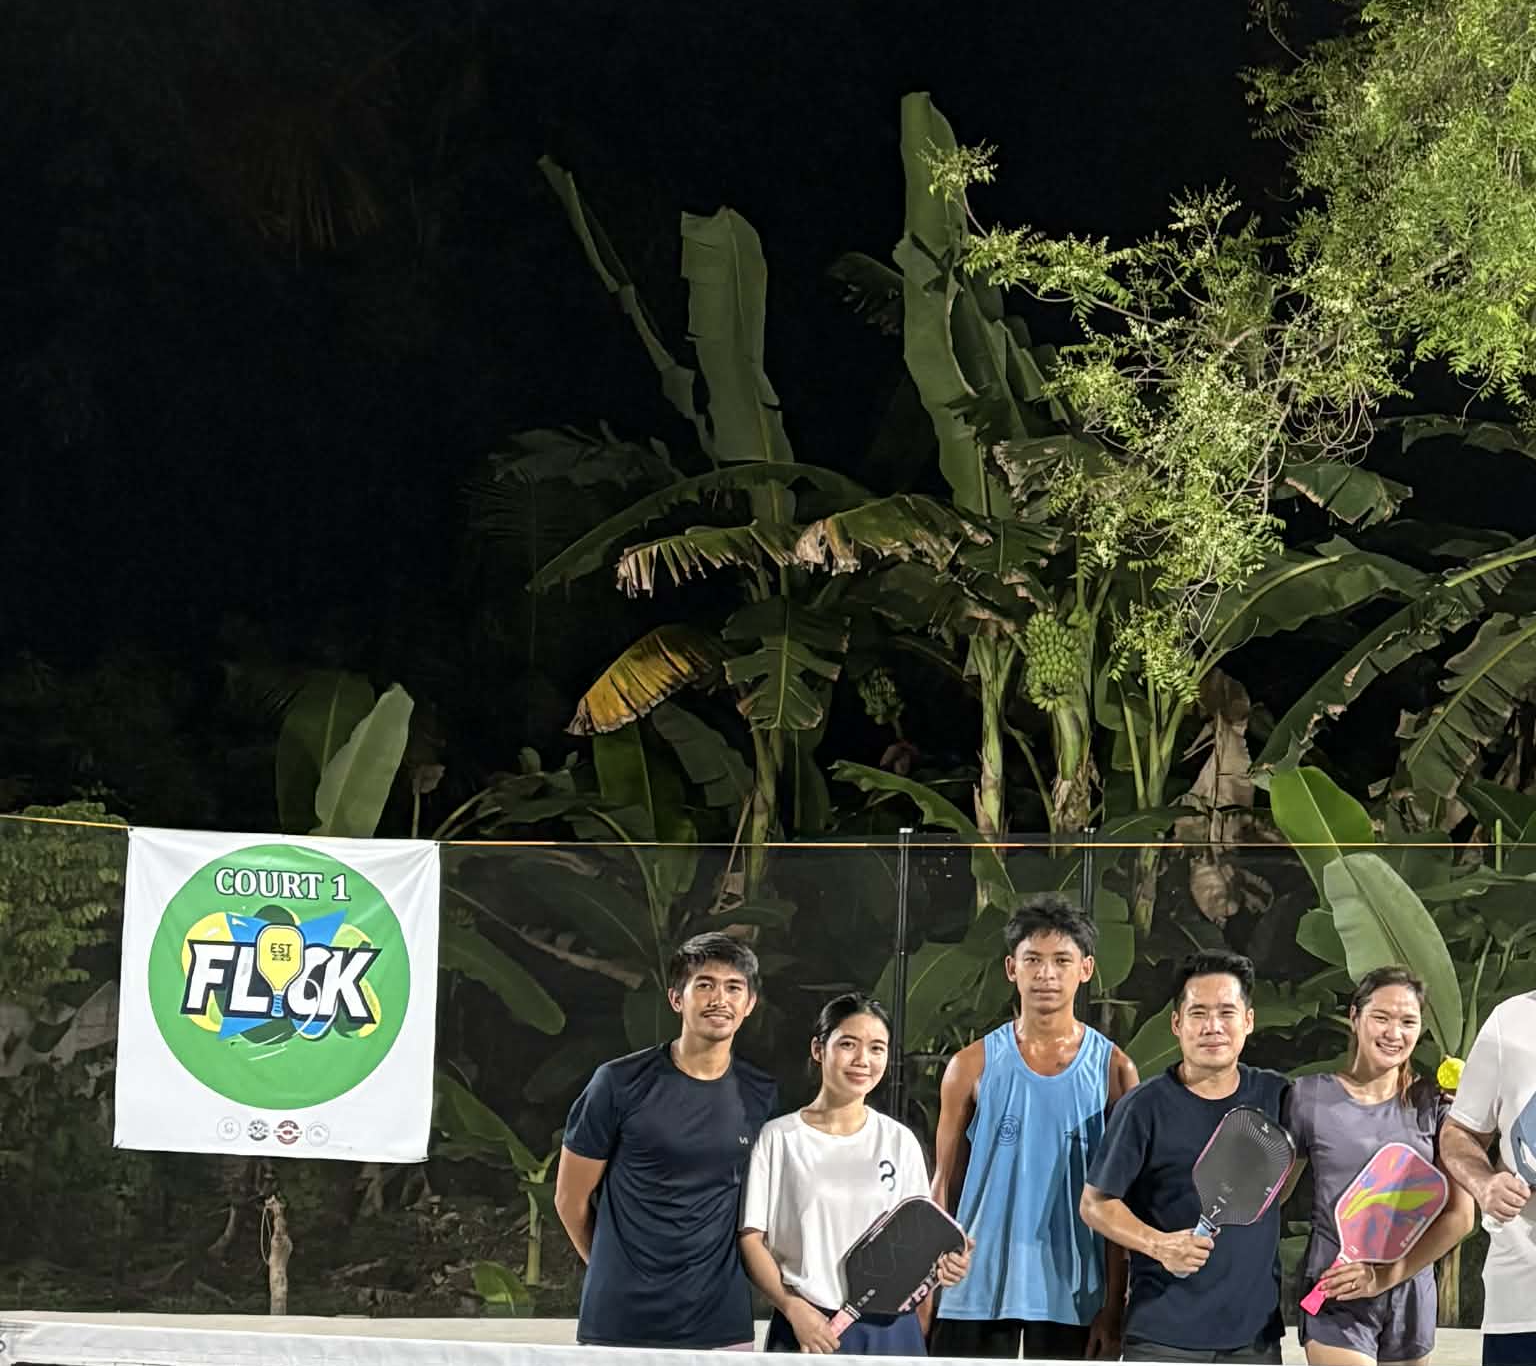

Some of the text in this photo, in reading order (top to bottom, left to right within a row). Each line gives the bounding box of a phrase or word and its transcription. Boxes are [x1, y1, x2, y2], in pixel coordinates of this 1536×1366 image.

[215, 867, 351, 901] COURT 1
[270, 943, 292, 955] EST
